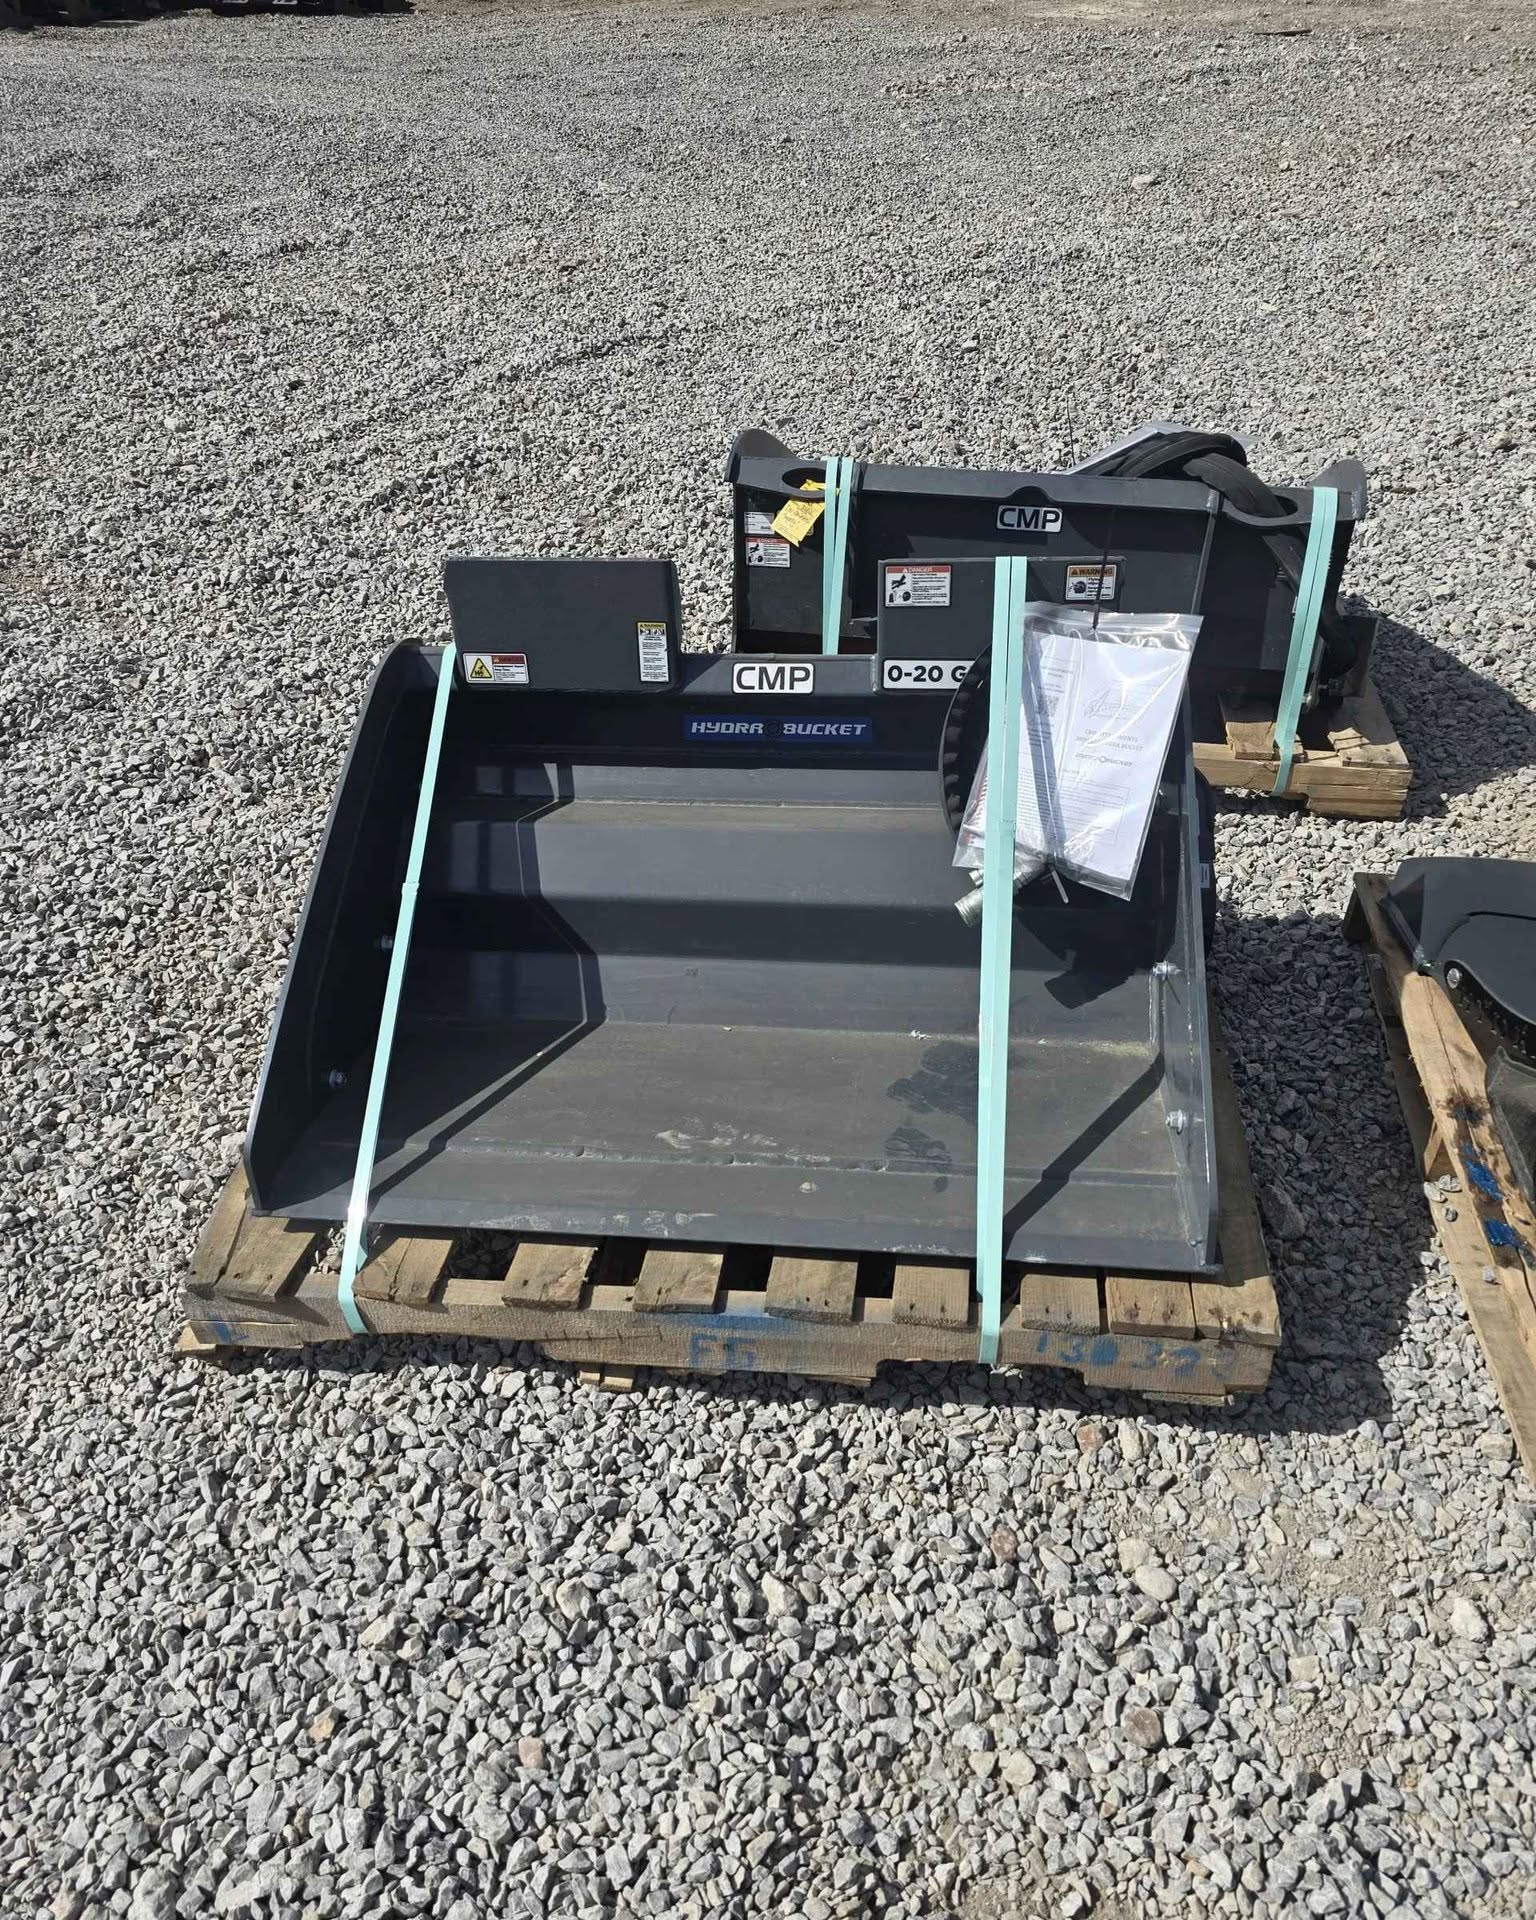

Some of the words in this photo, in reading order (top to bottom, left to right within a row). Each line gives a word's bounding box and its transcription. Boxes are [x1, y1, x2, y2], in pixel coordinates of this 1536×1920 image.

[999, 508, 1061, 530] CMP
[1079, 567, 1113, 576] WARNNG
[736, 666, 812, 690] CMP
[887, 665, 943, 682] 0-20
[691, 722, 763, 734] HYDRA
[783, 723, 866, 735] BUCKET
